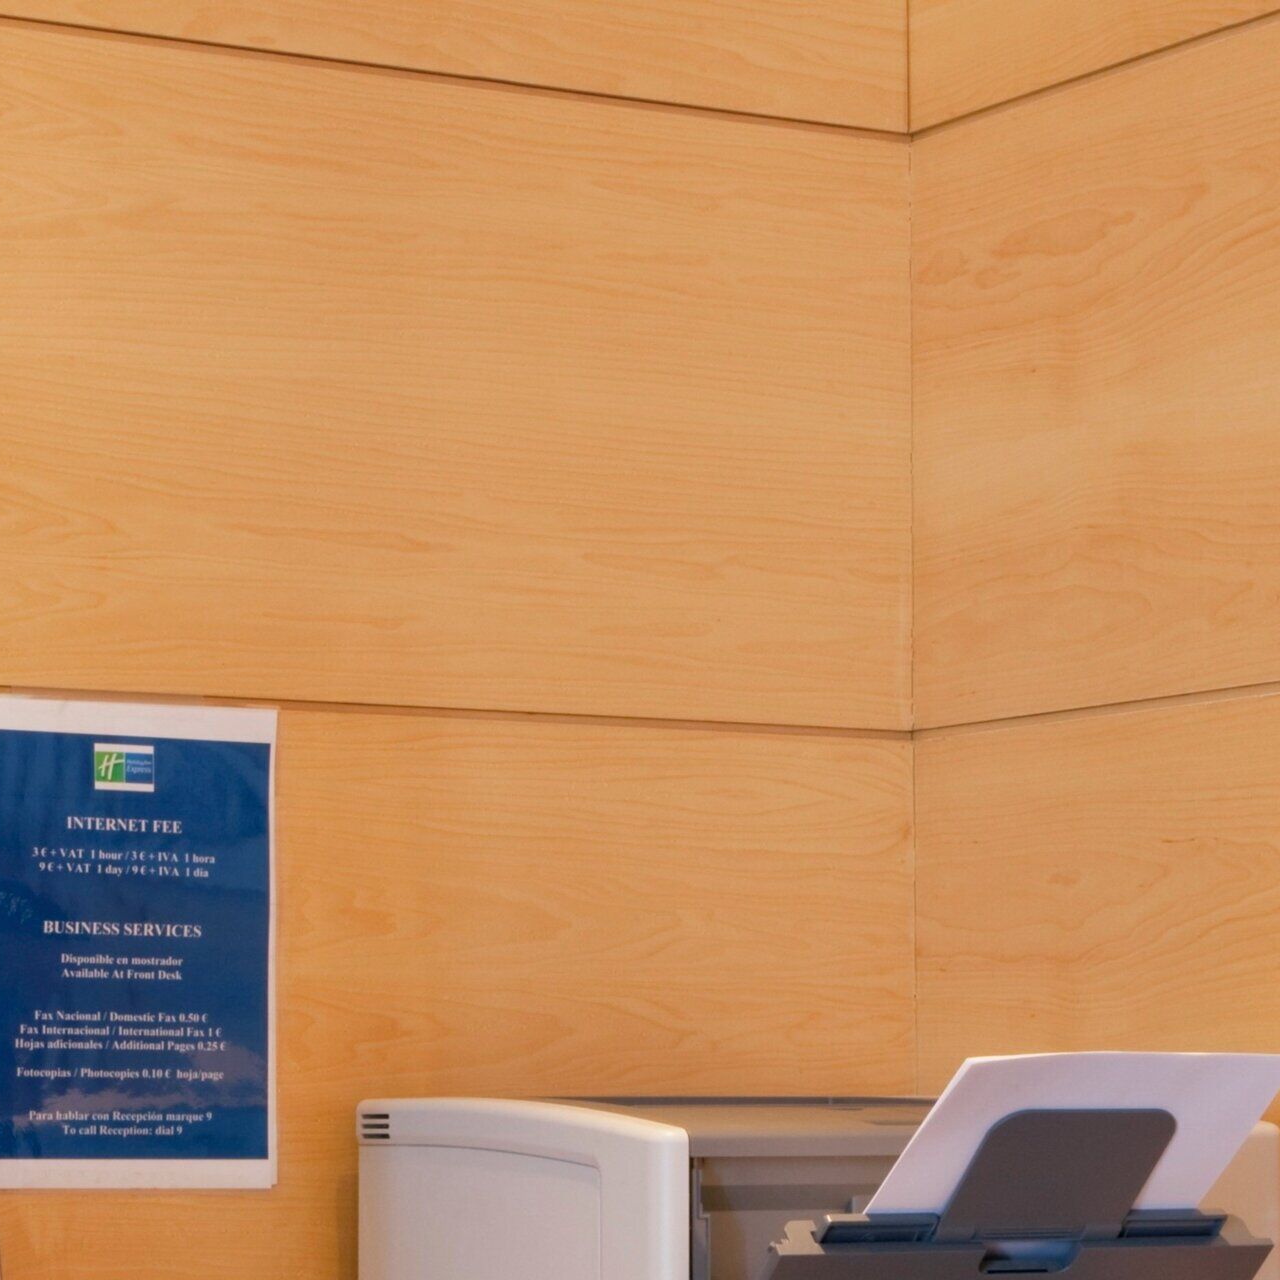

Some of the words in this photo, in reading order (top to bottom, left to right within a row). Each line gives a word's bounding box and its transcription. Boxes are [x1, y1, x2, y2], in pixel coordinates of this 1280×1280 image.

[67, 816, 148, 833] INTERNET
[152, 820, 183, 834] FEE
[60, 848, 85, 859] VAT
[99, 850, 123, 861] hour
[158, 852, 178, 863] IVA
[193, 854, 215, 864] hora
[67, 864, 91, 874] VAT
[105, 865, 123, 877] day
[159, 867, 179, 877] IVA
[43, 920, 120, 936] BUSINESS
[124, 923, 202, 938] SERVICES
[61, 953, 114, 967] Disponible
[116, 957, 128, 965] en
[131, 956, 183, 966] mostrador
[61, 969, 108, 979] Available
[112, 970, 124, 979] At
[127, 970, 154, 980] Front
[158, 971, 182, 980] Desk
[35, 1010, 53, 1021] Fax
[56, 1011, 101, 1022] Nacional
[109, 1011, 155, 1022] Domestic
[158, 1012, 176, 1022] Fax
[179, 1013, 199, 1022] 0.50
[20, 1024, 38, 1035] Fax
[42, 1025, 109, 1036] Internacional
[119, 1026, 183, 1037] International
[187, 1027, 205, 1037] Fax
[15, 1038, 45, 1051] Hojas
[47, 1039, 103, 1050] adicionales
[112, 1040, 164, 1051] Additional
[167, 1041, 195, 1053] Pages
[197, 1042, 218, 1051] 0.25
[16, 1067, 71, 1080] Fotocopias
[80, 1068, 140, 1081] Photocopies
[142, 1069, 163, 1079] 0.10
[176, 1070, 224, 1082] hoja/page
[29, 1111, 53, 1121] Para
[56, 1111, 89, 1121] hablar
[92, 1113, 110, 1121] con
[113, 1111, 162, 1123] Recepción
[166, 1114, 204, 1123] marque
[62, 1126, 76, 1135] To
[79, 1126, 97, 1135] call
[100, 1126, 152, 1137] Reception:
[156, 1126, 173, 1135] dial
